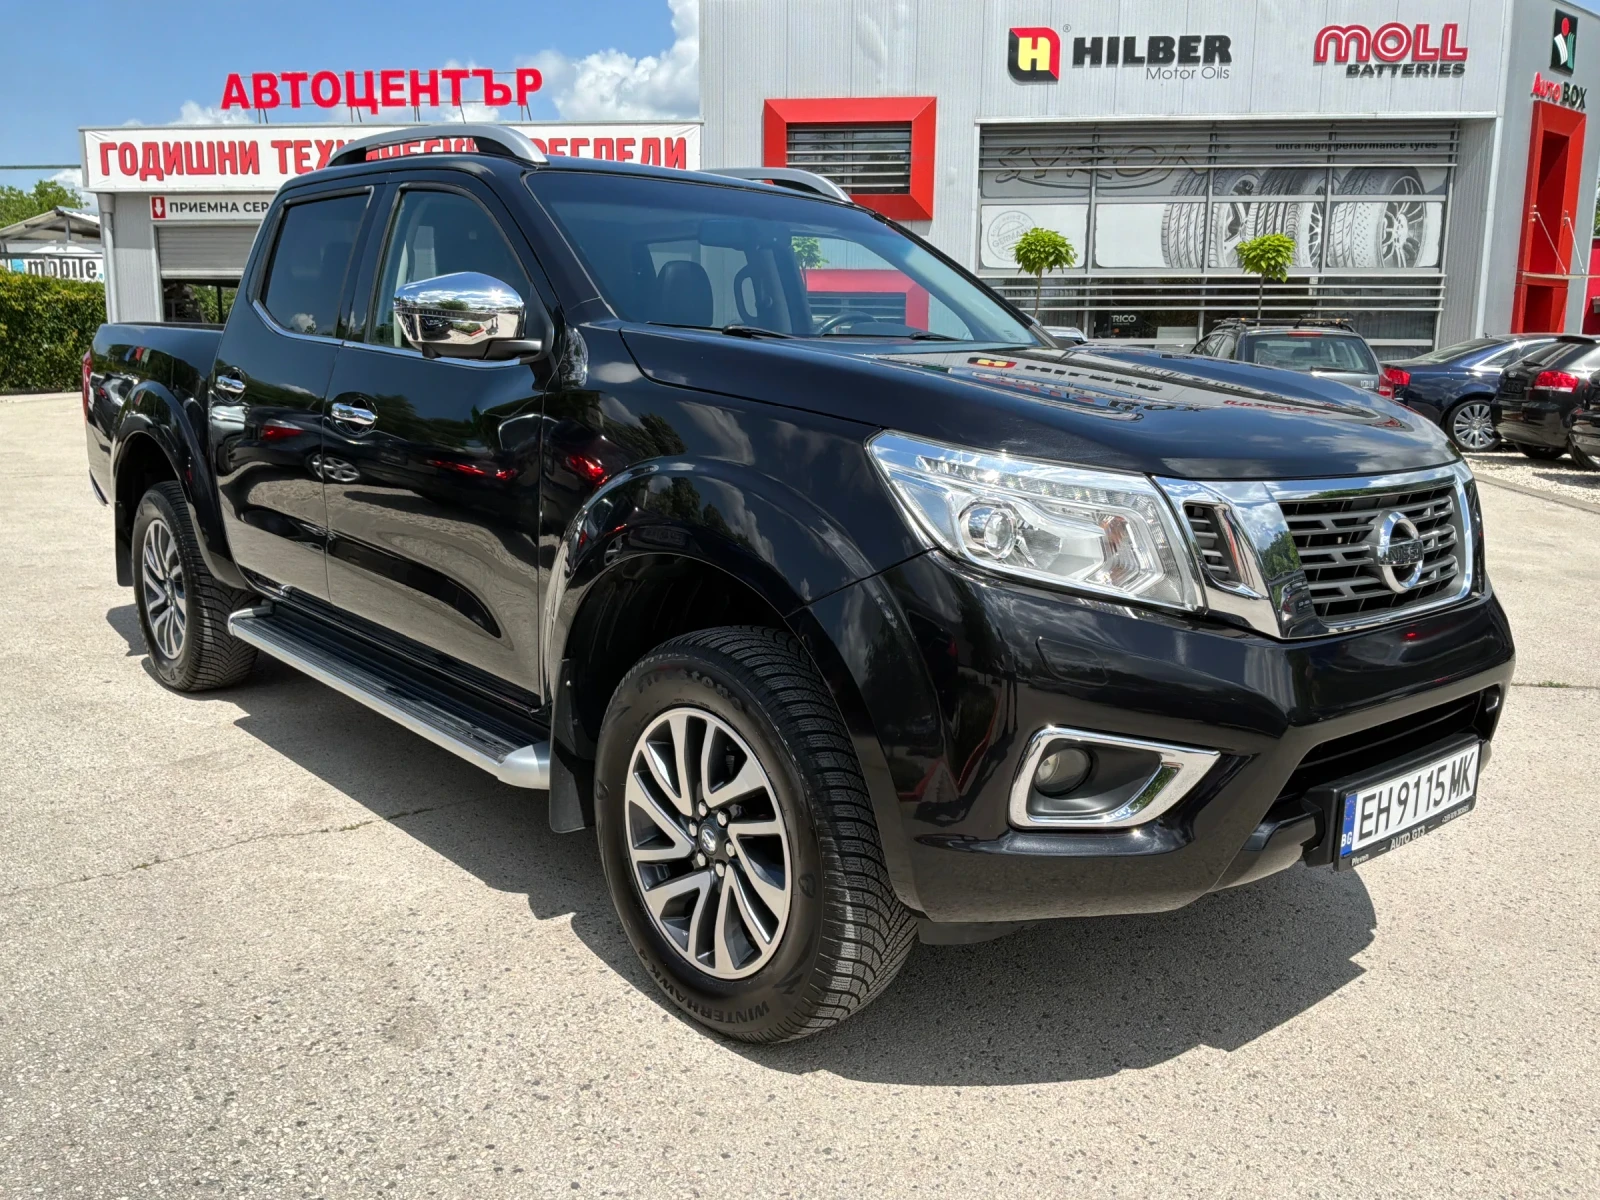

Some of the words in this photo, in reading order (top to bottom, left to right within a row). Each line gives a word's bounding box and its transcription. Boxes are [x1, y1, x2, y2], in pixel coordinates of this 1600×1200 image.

[1072, 35, 1232, 67] HILBER
[1146, 66, 1196, 80] Motor
[1201, 66, 1230, 80] Oils
[1346, 63, 1466, 78] BATTERIES
[220, 68, 543, 115] АВТОЦЕНТЪР
[100, 140, 260, 181] ГОДИШНИ
[169, 201, 240, 213] ПРИЕМНА
[1341, 831, 1353, 848] BG
[1389, 834, 1411, 851] AUTO
[651, 963, 770, 1024] WINTERHAWK
